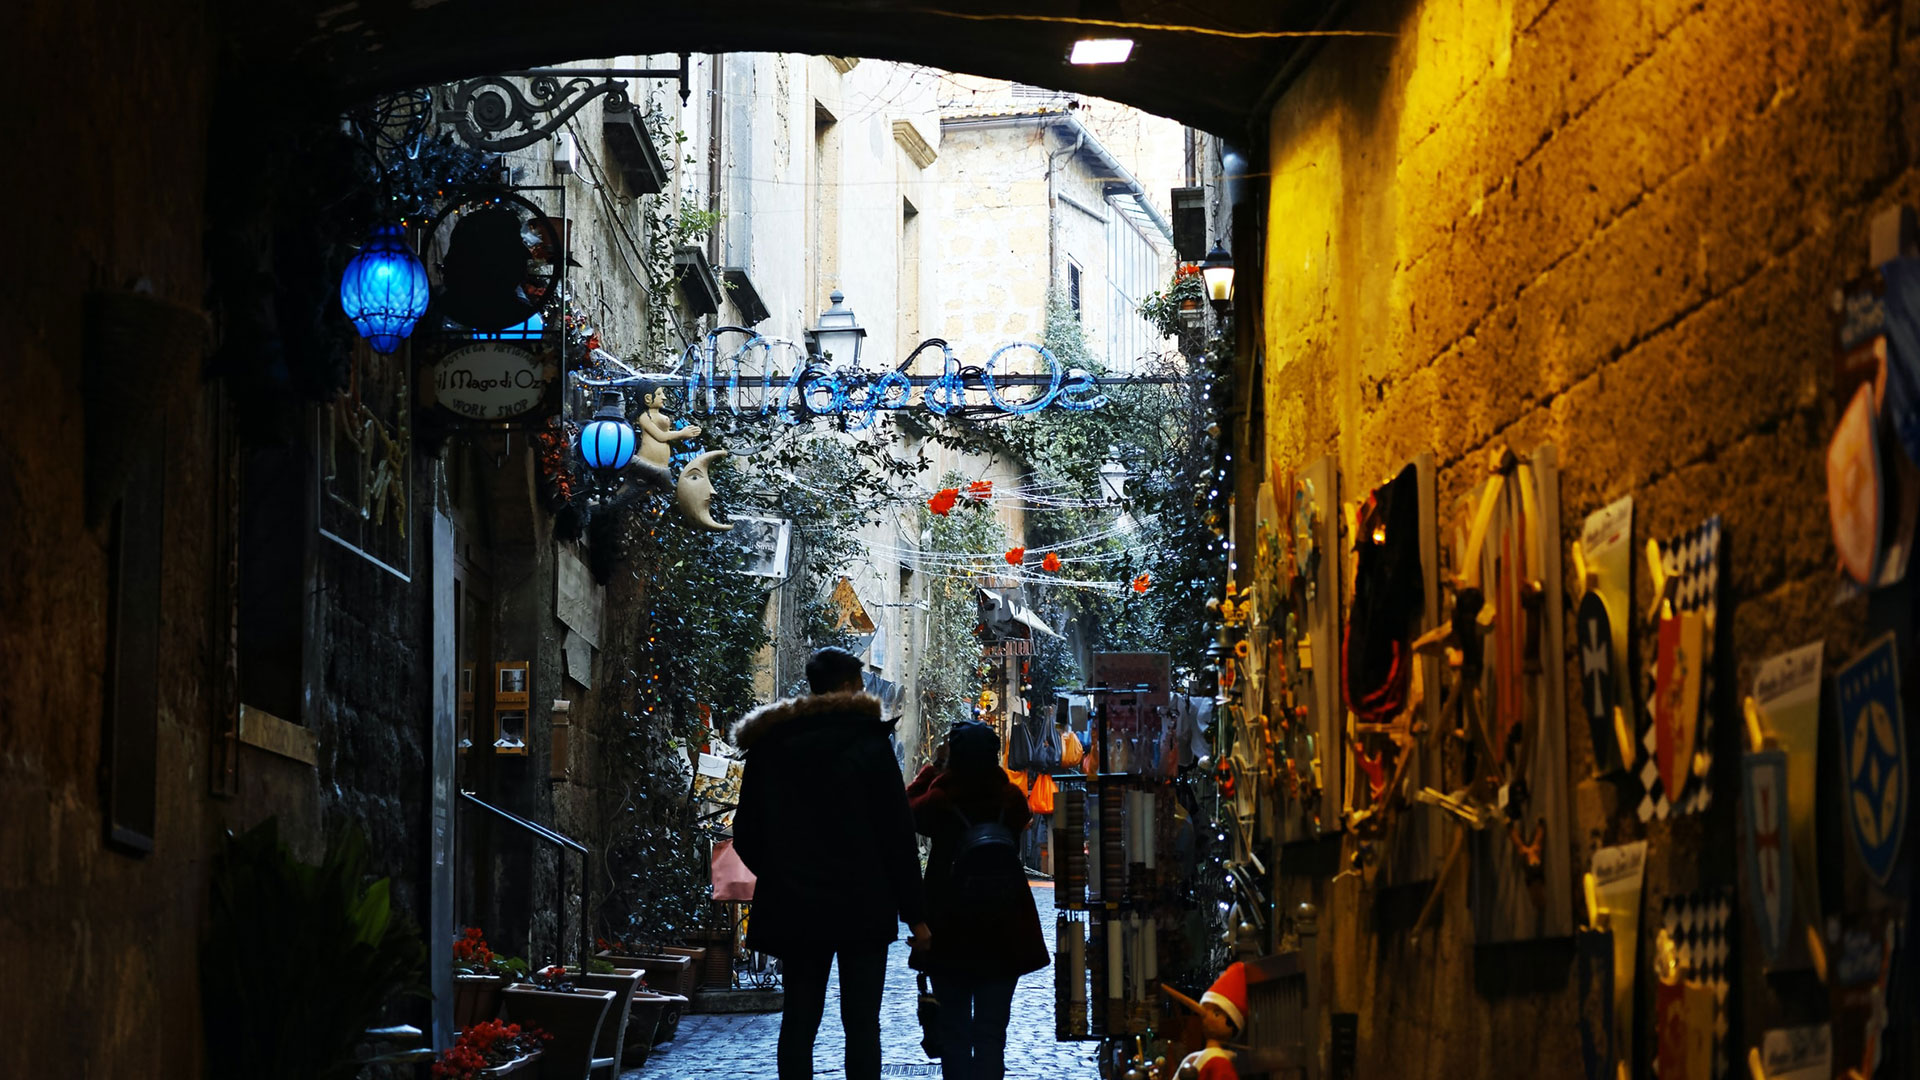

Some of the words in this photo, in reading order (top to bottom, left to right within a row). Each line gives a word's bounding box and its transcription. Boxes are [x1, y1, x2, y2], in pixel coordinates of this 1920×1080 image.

[451, 369, 498, 392] Mago
[500, 371, 512, 388] di
[515, 369, 544, 389] Oz
[453, 399, 487, 417] WORK
[497, 399, 528, 417] SHOP
